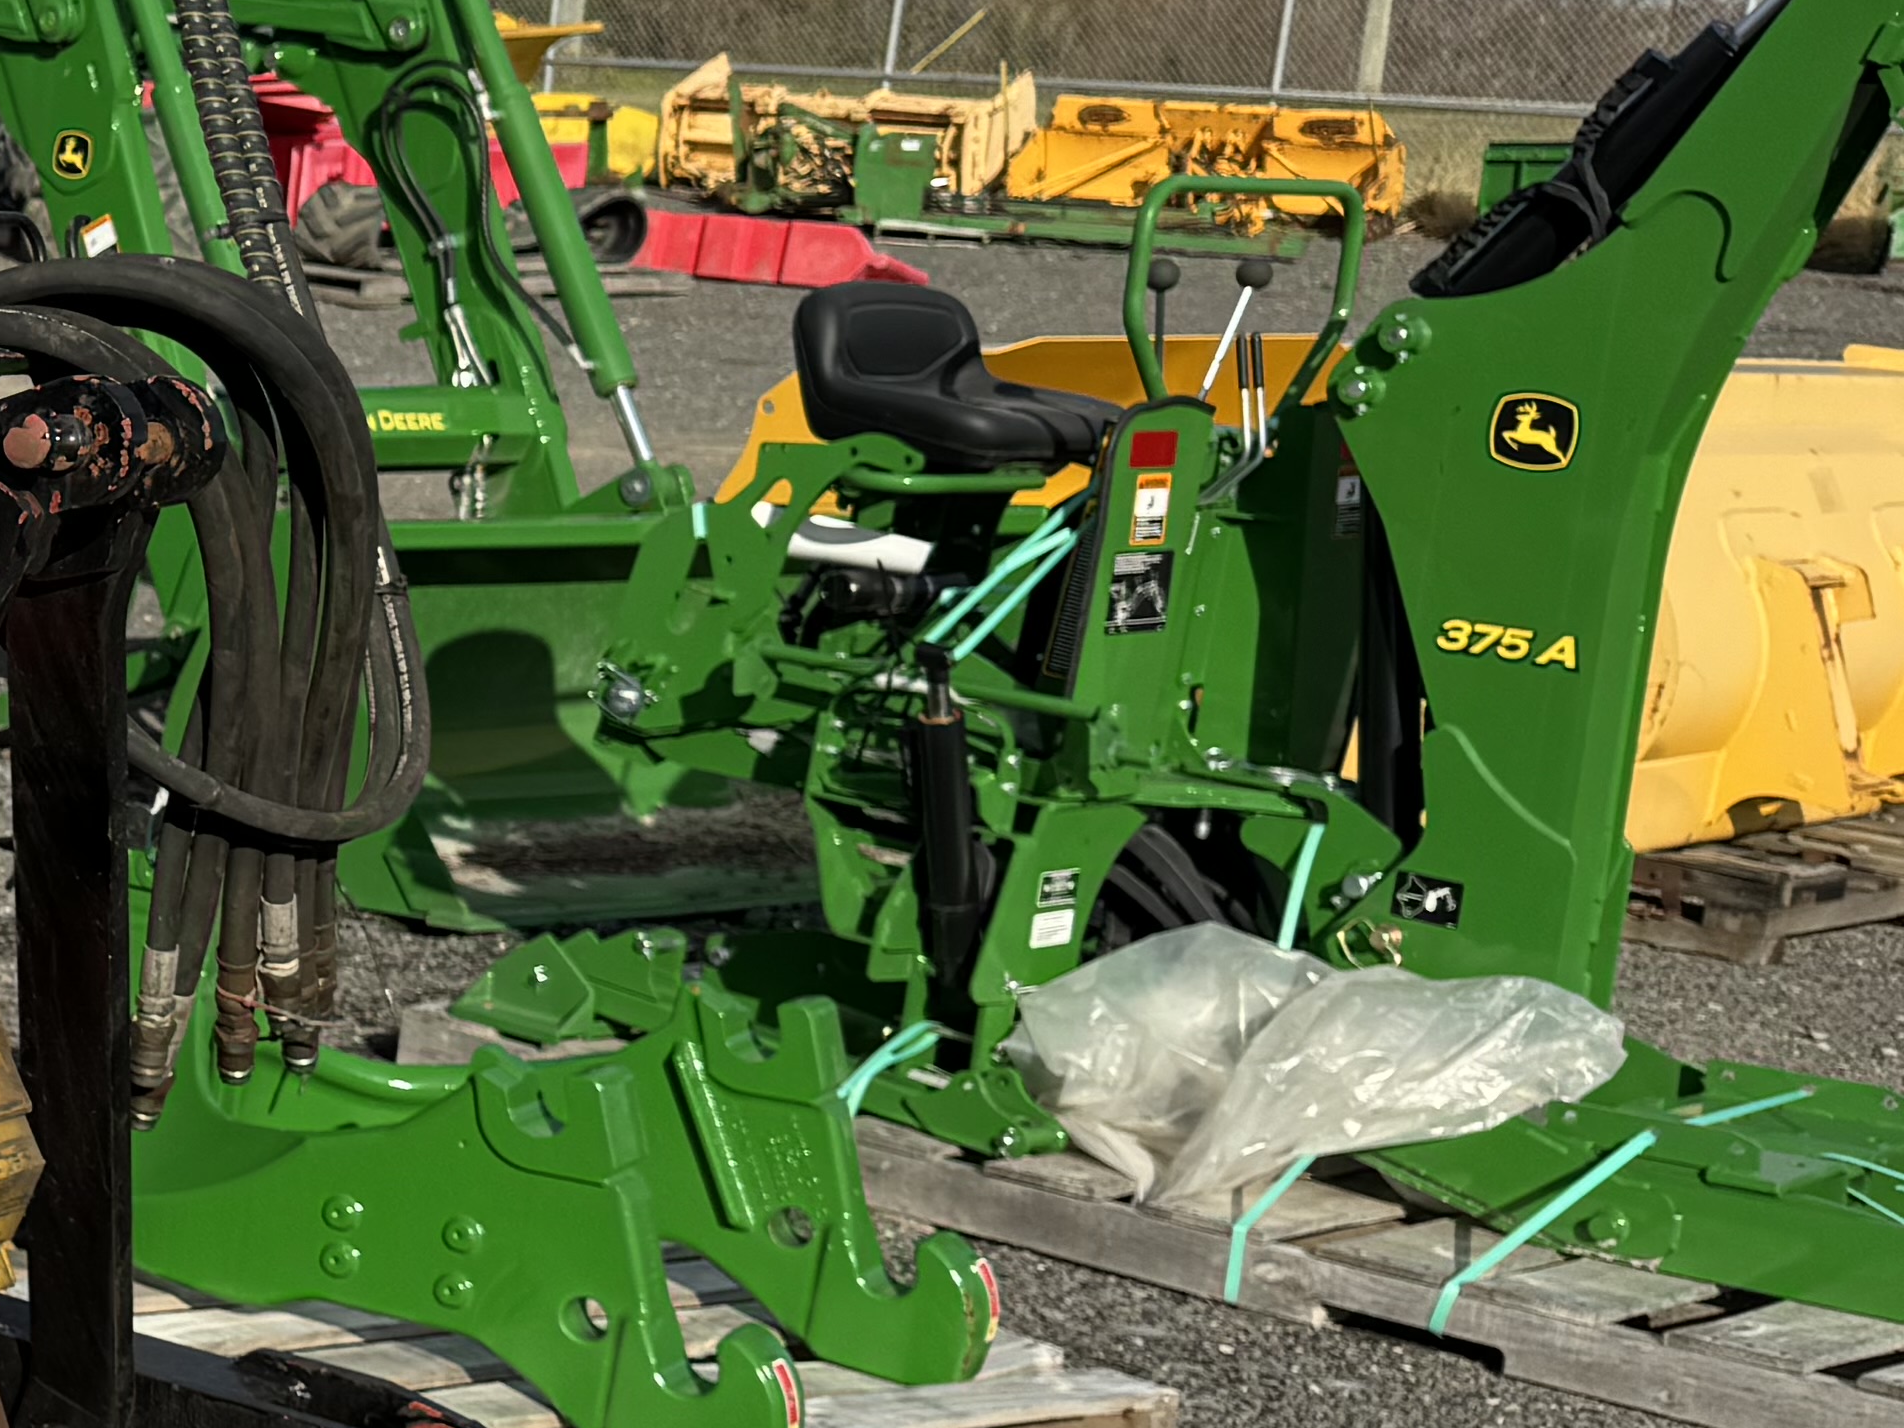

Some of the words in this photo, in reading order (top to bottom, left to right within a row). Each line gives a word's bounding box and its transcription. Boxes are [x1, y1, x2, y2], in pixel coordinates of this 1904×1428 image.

[377, 409, 446, 431] DEERE
[1436, 619, 1534, 660] 375
[1534, 635, 1577, 669] A
